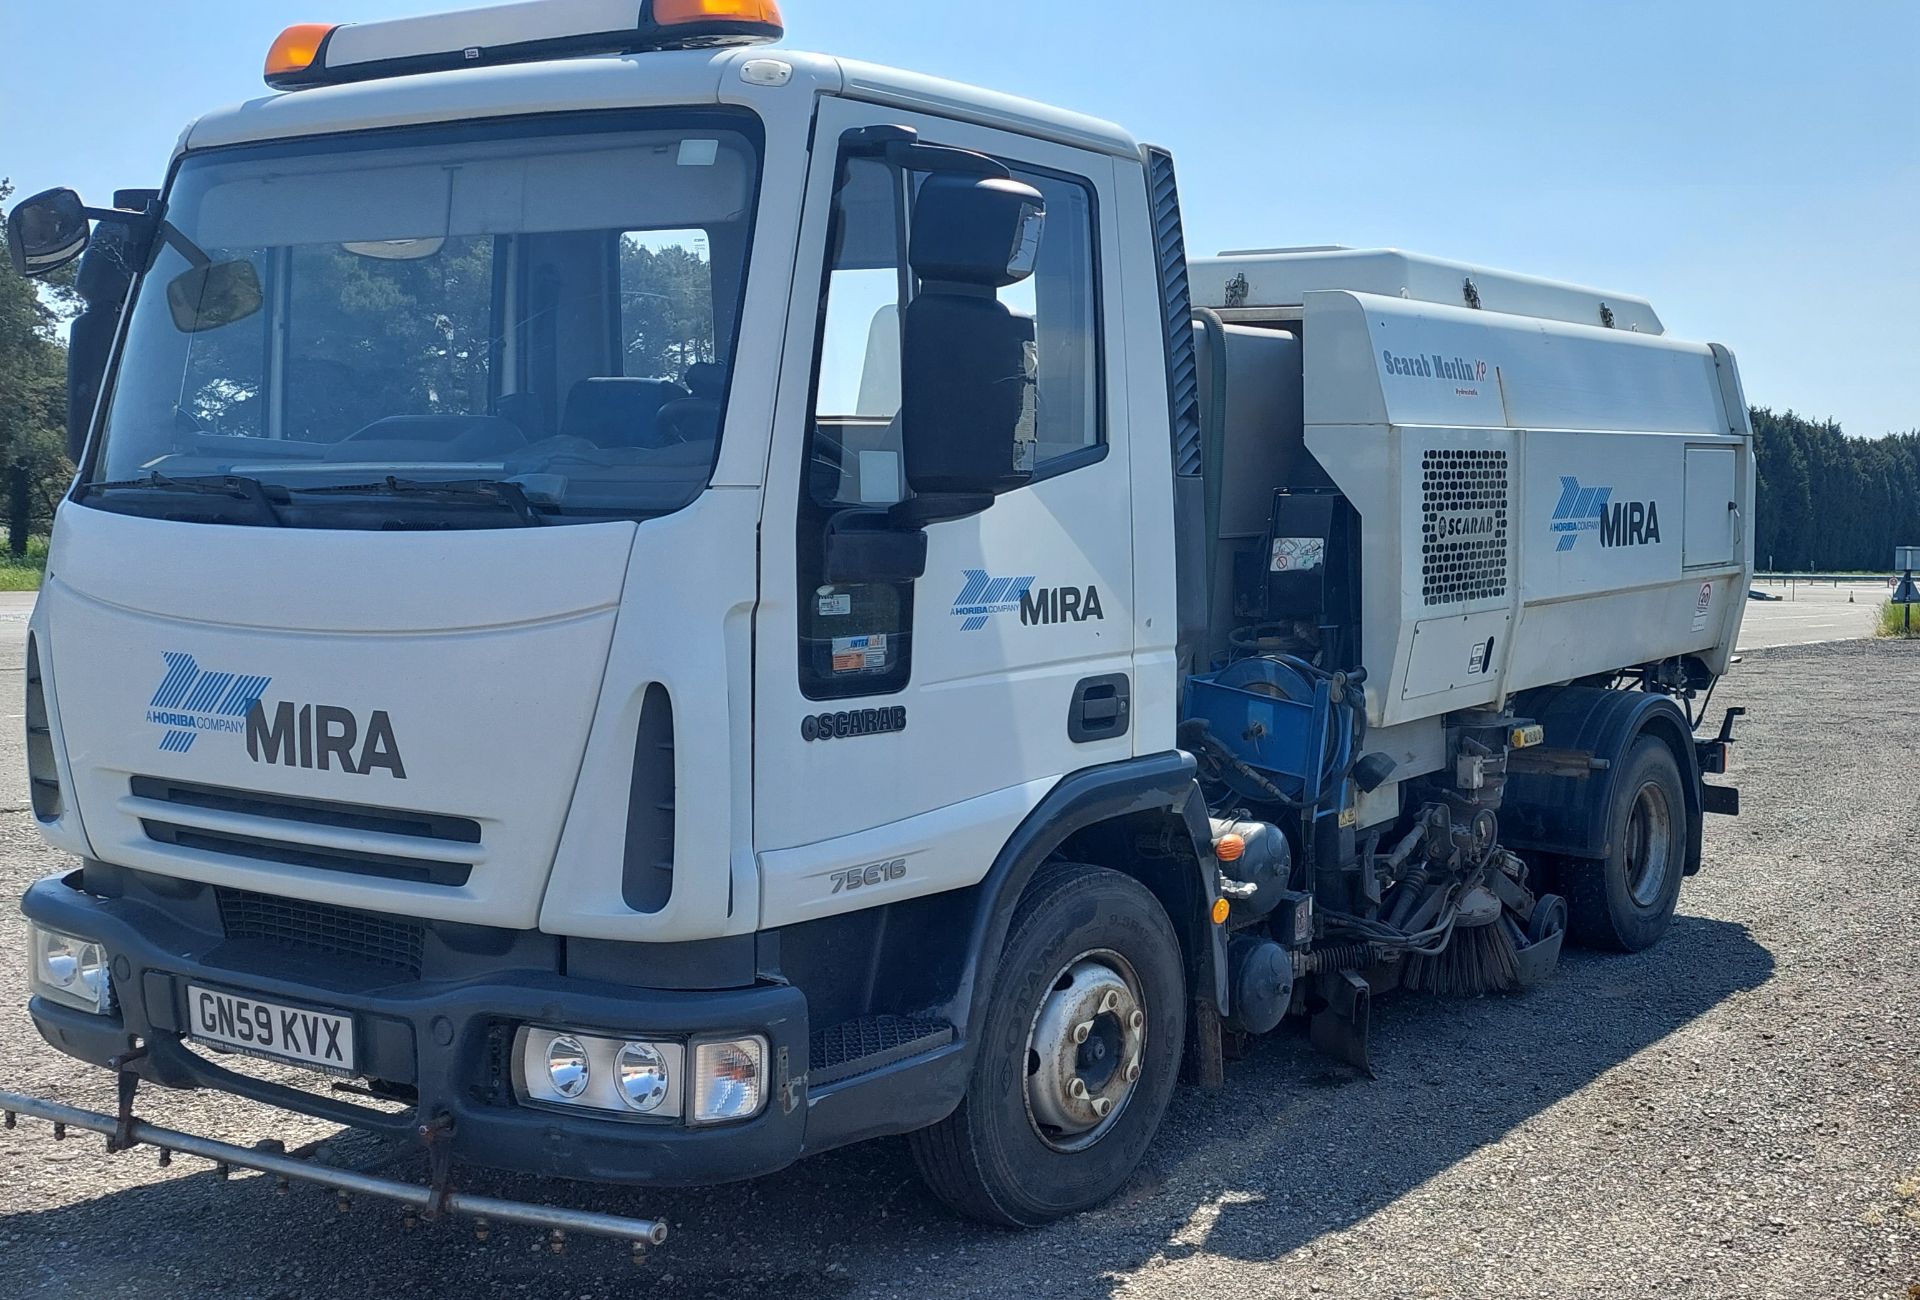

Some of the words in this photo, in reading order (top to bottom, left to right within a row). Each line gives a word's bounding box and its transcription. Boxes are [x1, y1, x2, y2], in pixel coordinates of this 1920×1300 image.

[1383, 349, 1432, 378] Scarab
[1432, 354, 1475, 381] Merlin
[1553, 522, 1578, 532] HORIBA
[1577, 520, 1600, 531] COMPANY
[1600, 501, 1661, 548] MIRA
[955, 606, 988, 616] HORIBA
[987, 603, 1020, 614] COMPANY
[1020, 585, 1104, 626] MIRA
[146, 710, 153, 723] A
[152, 711, 197, 729] HORIBA
[196, 716, 245, 734] COMPANY
[246, 697, 407, 780] MIRA
[830, 859, 907, 894] 75E16
[200, 992, 274, 1046] GN59
[280, 1009, 343, 1062] KVX
